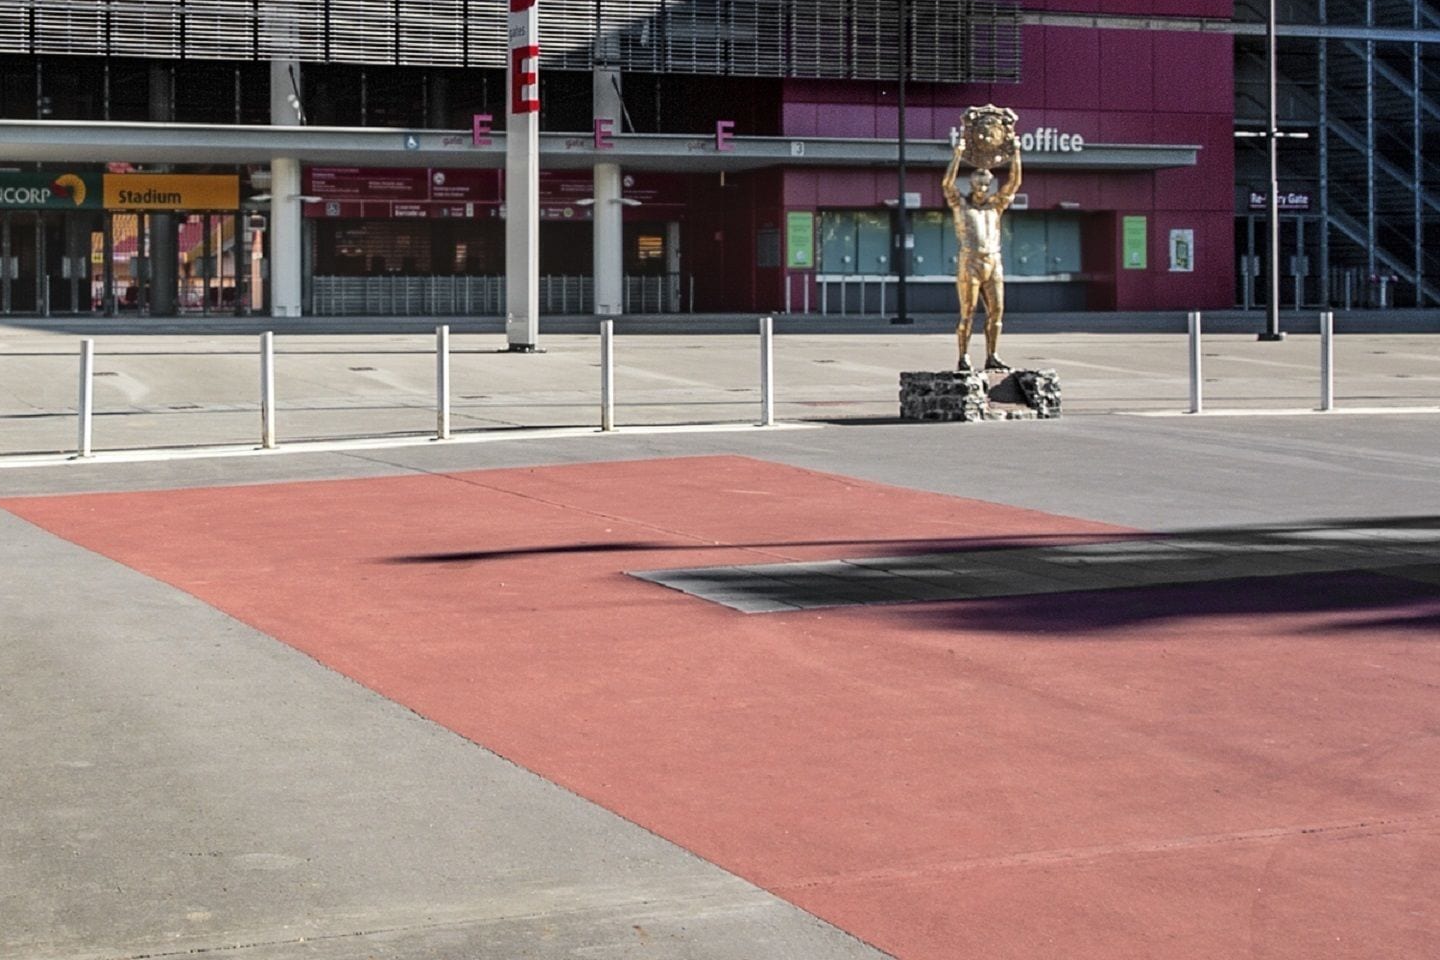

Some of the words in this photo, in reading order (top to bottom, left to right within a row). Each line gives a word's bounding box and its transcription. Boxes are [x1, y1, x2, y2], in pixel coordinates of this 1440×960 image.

[512, 46, 540, 114] E
[472, 114, 493, 145] E
[594, 119, 614, 148] E
[716, 120, 735, 151] E
[1021, 127, 1084, 152] office
[118, 188, 182, 204] Stadium
[1288, 193, 1308, 204] Gate
